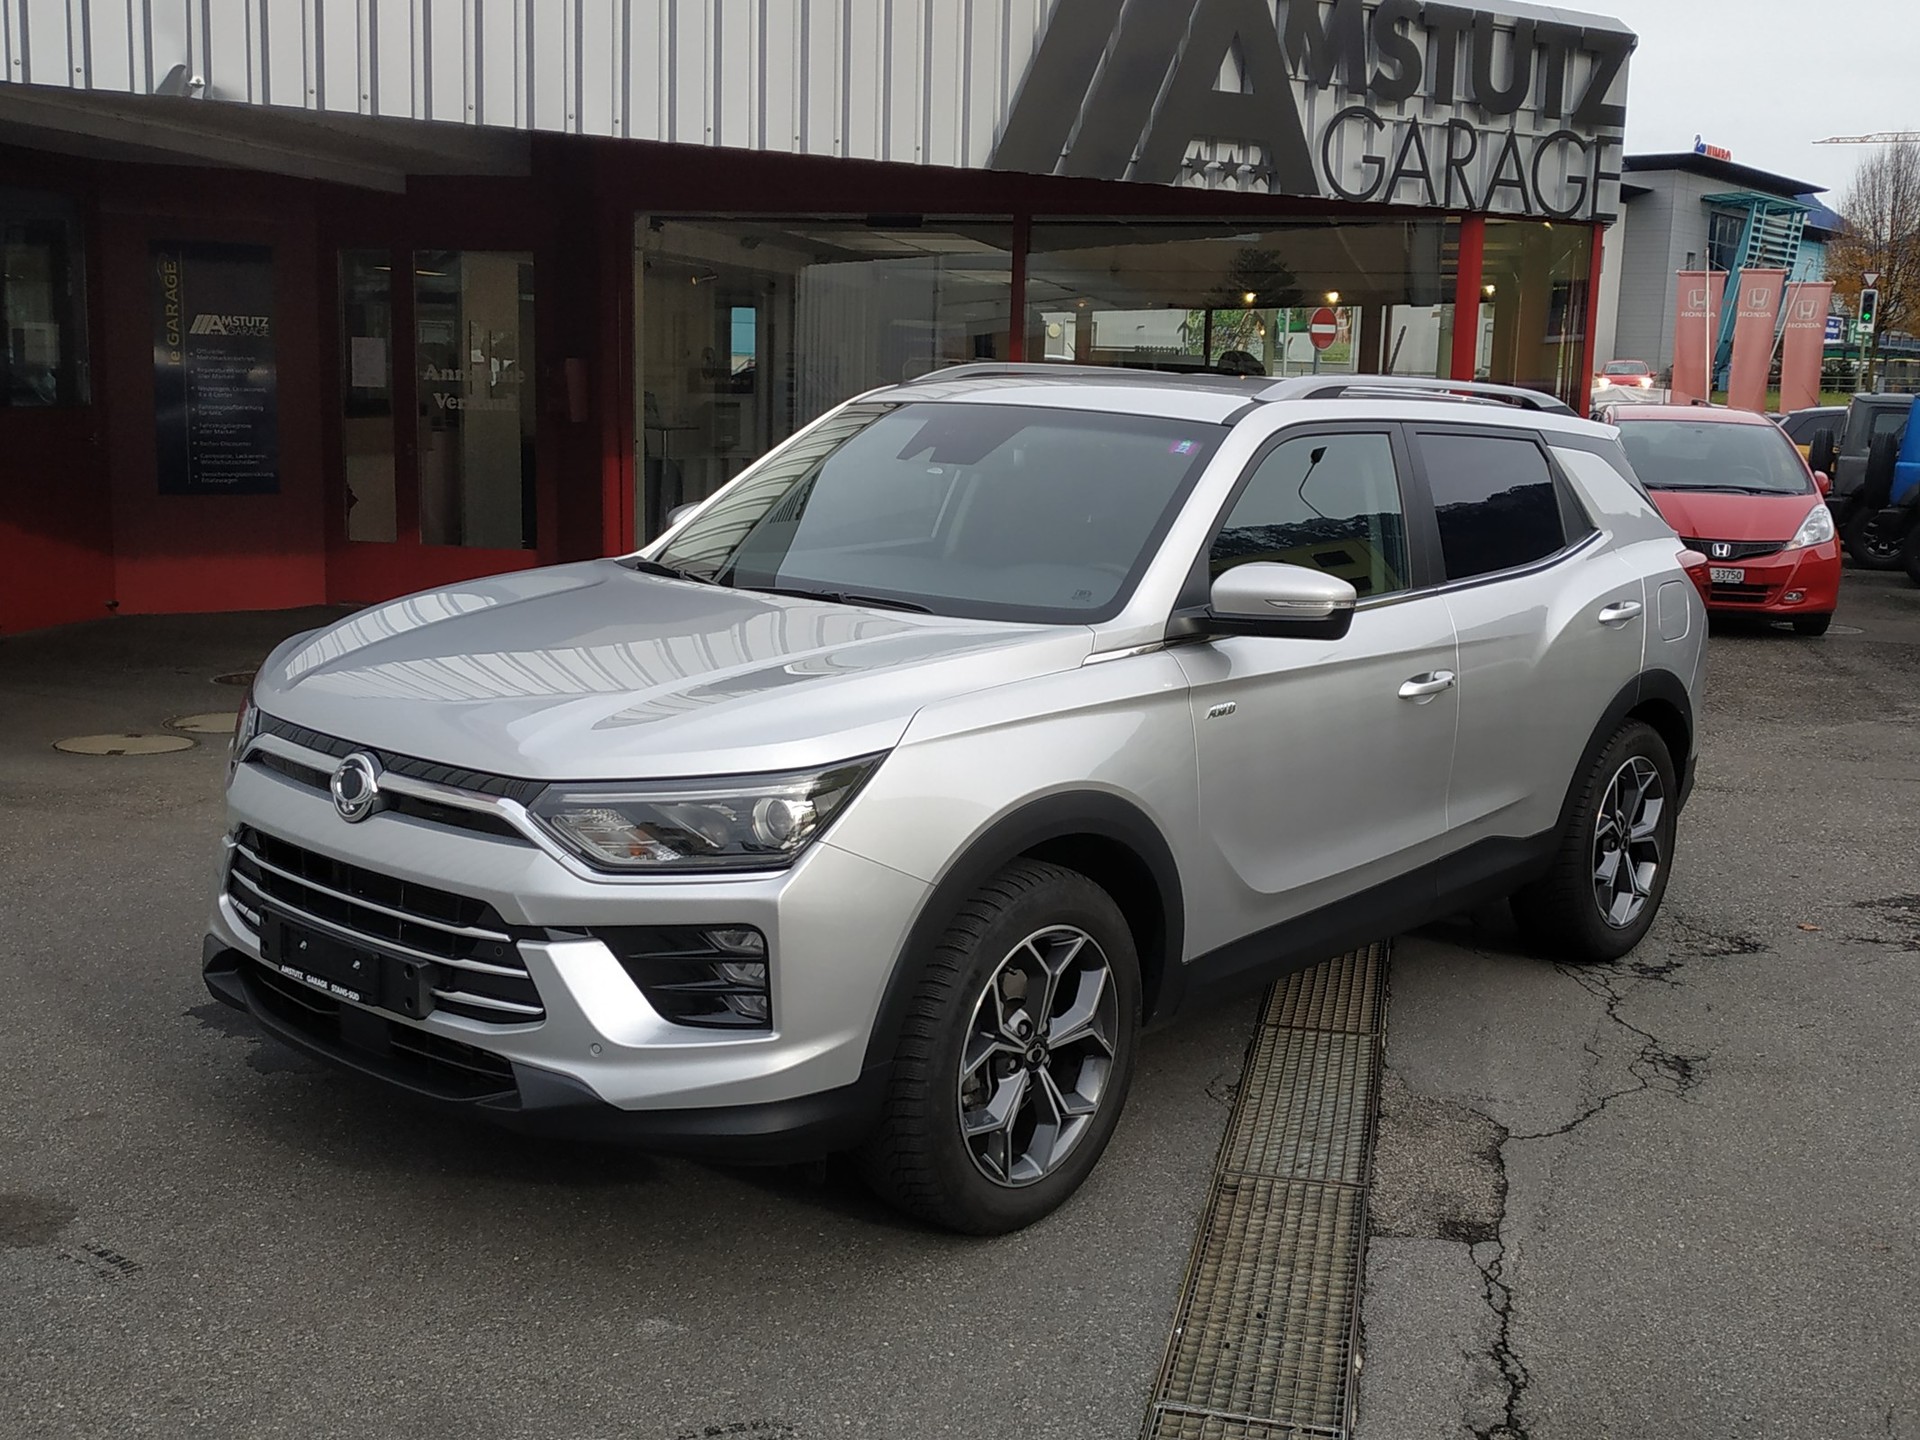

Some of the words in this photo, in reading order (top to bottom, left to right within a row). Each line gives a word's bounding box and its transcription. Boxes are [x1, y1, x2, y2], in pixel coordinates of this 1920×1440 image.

[1118, 0, 1638, 198] AMSTUTZ
[1321, 105, 1623, 223] GARAGE
[164, 261, 180, 346] GARAGE
[200, 315, 269, 335] AMSTUTZ
[227, 326, 270, 337] GARAGE
[1715, 569, 1742, 580] 33750
[281, 964, 304, 980] AMSTUTZ
[306, 974, 328, 989] GARAGE
